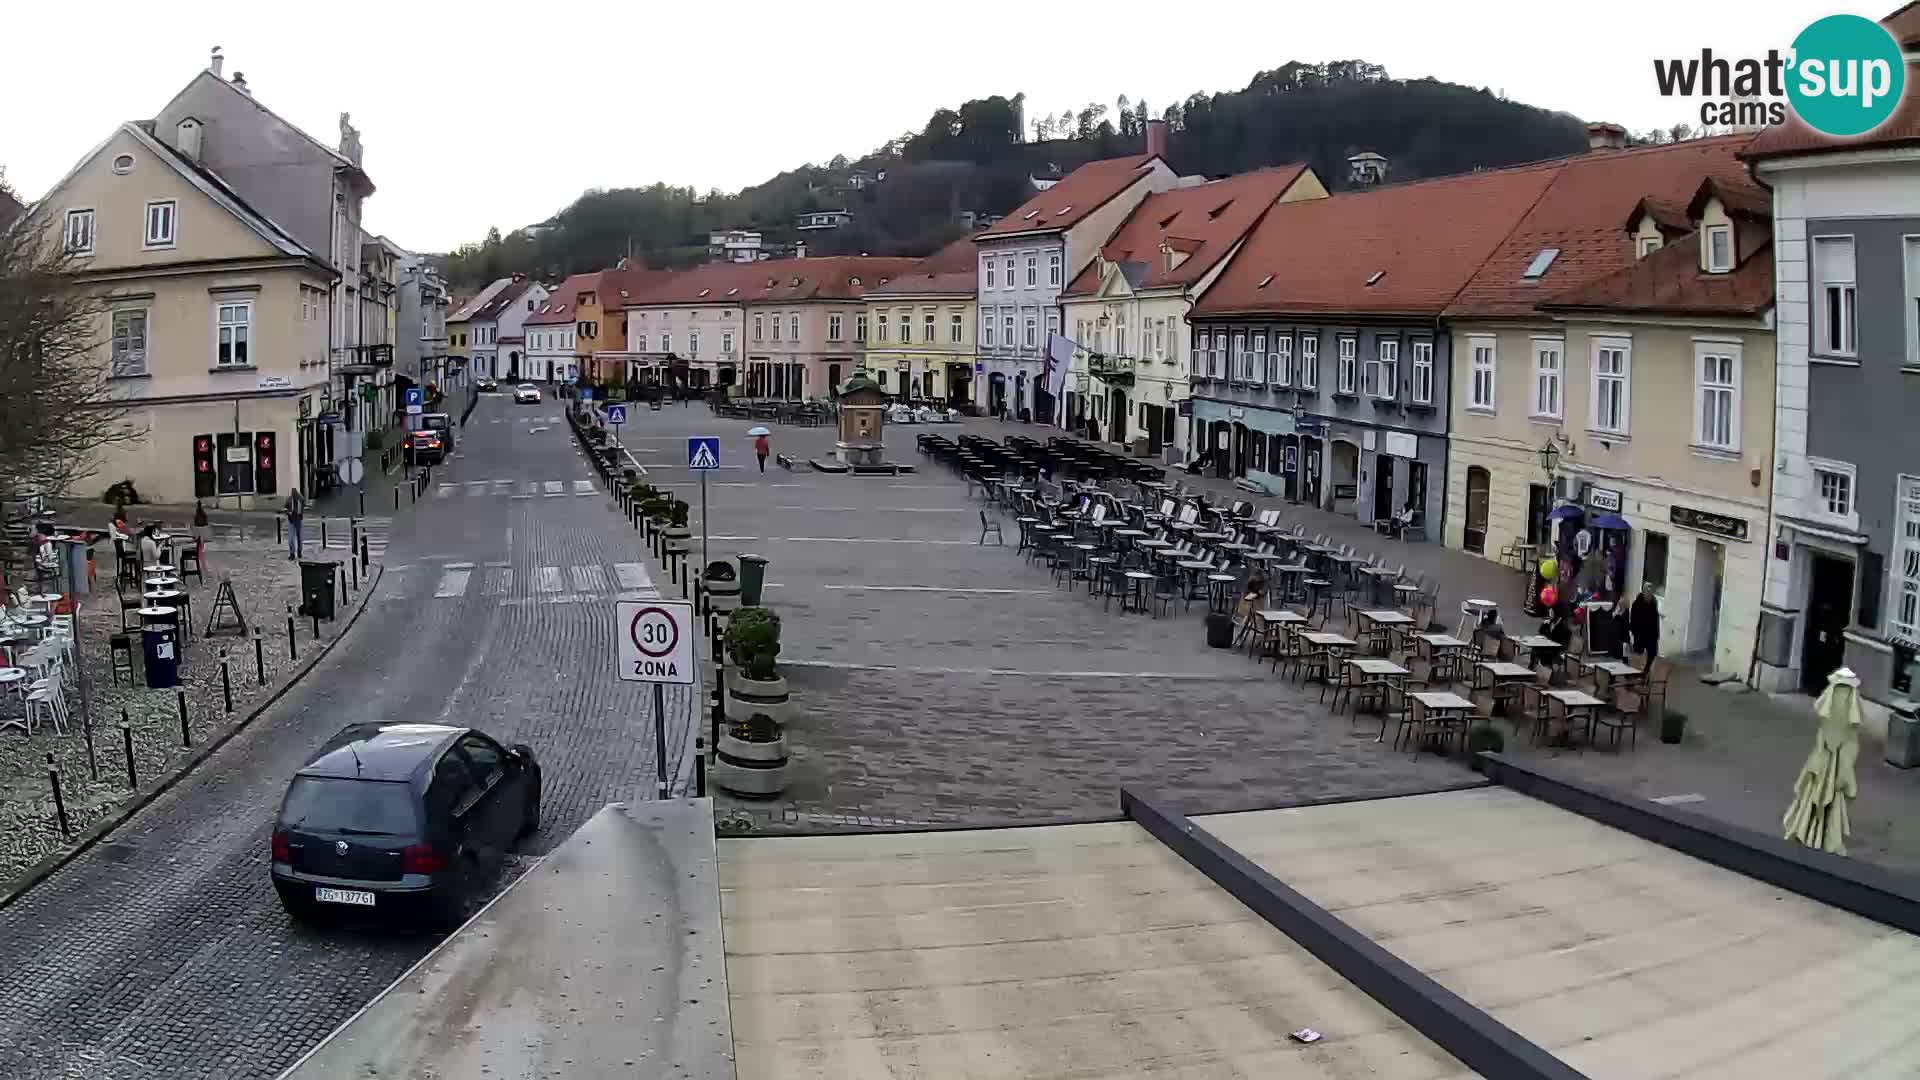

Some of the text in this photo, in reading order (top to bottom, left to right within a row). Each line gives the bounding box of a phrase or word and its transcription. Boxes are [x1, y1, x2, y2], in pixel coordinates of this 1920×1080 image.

[410, 392, 418, 402] P
[643, 623, 668, 644] 30
[633, 660, 679, 677] ZONA
